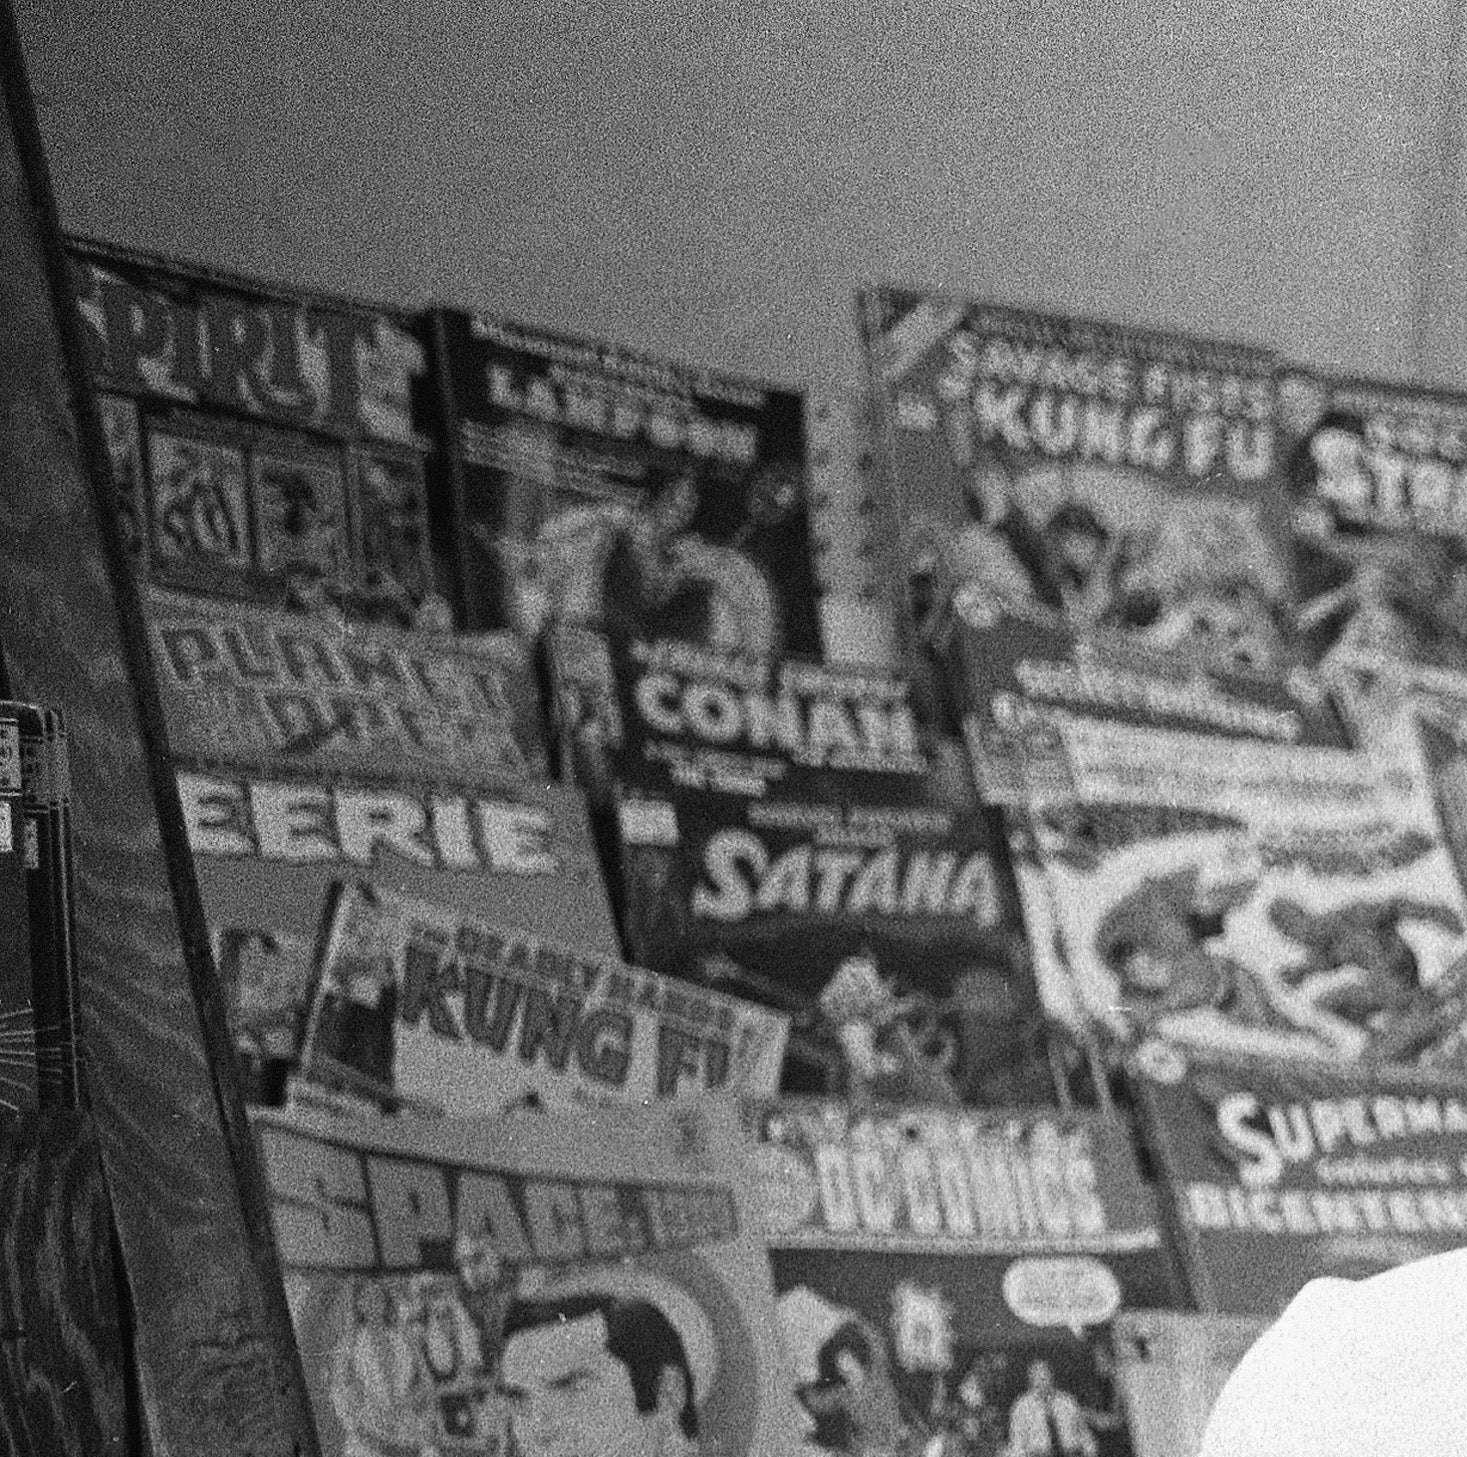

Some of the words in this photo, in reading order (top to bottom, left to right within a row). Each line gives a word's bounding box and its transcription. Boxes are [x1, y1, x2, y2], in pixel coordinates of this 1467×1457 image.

[1184, 416, 1274, 483] FU
[636, 668, 927, 776] CONAN
[176, 772, 560, 874] EERIE
[692, 826, 1000, 926] SATANA
